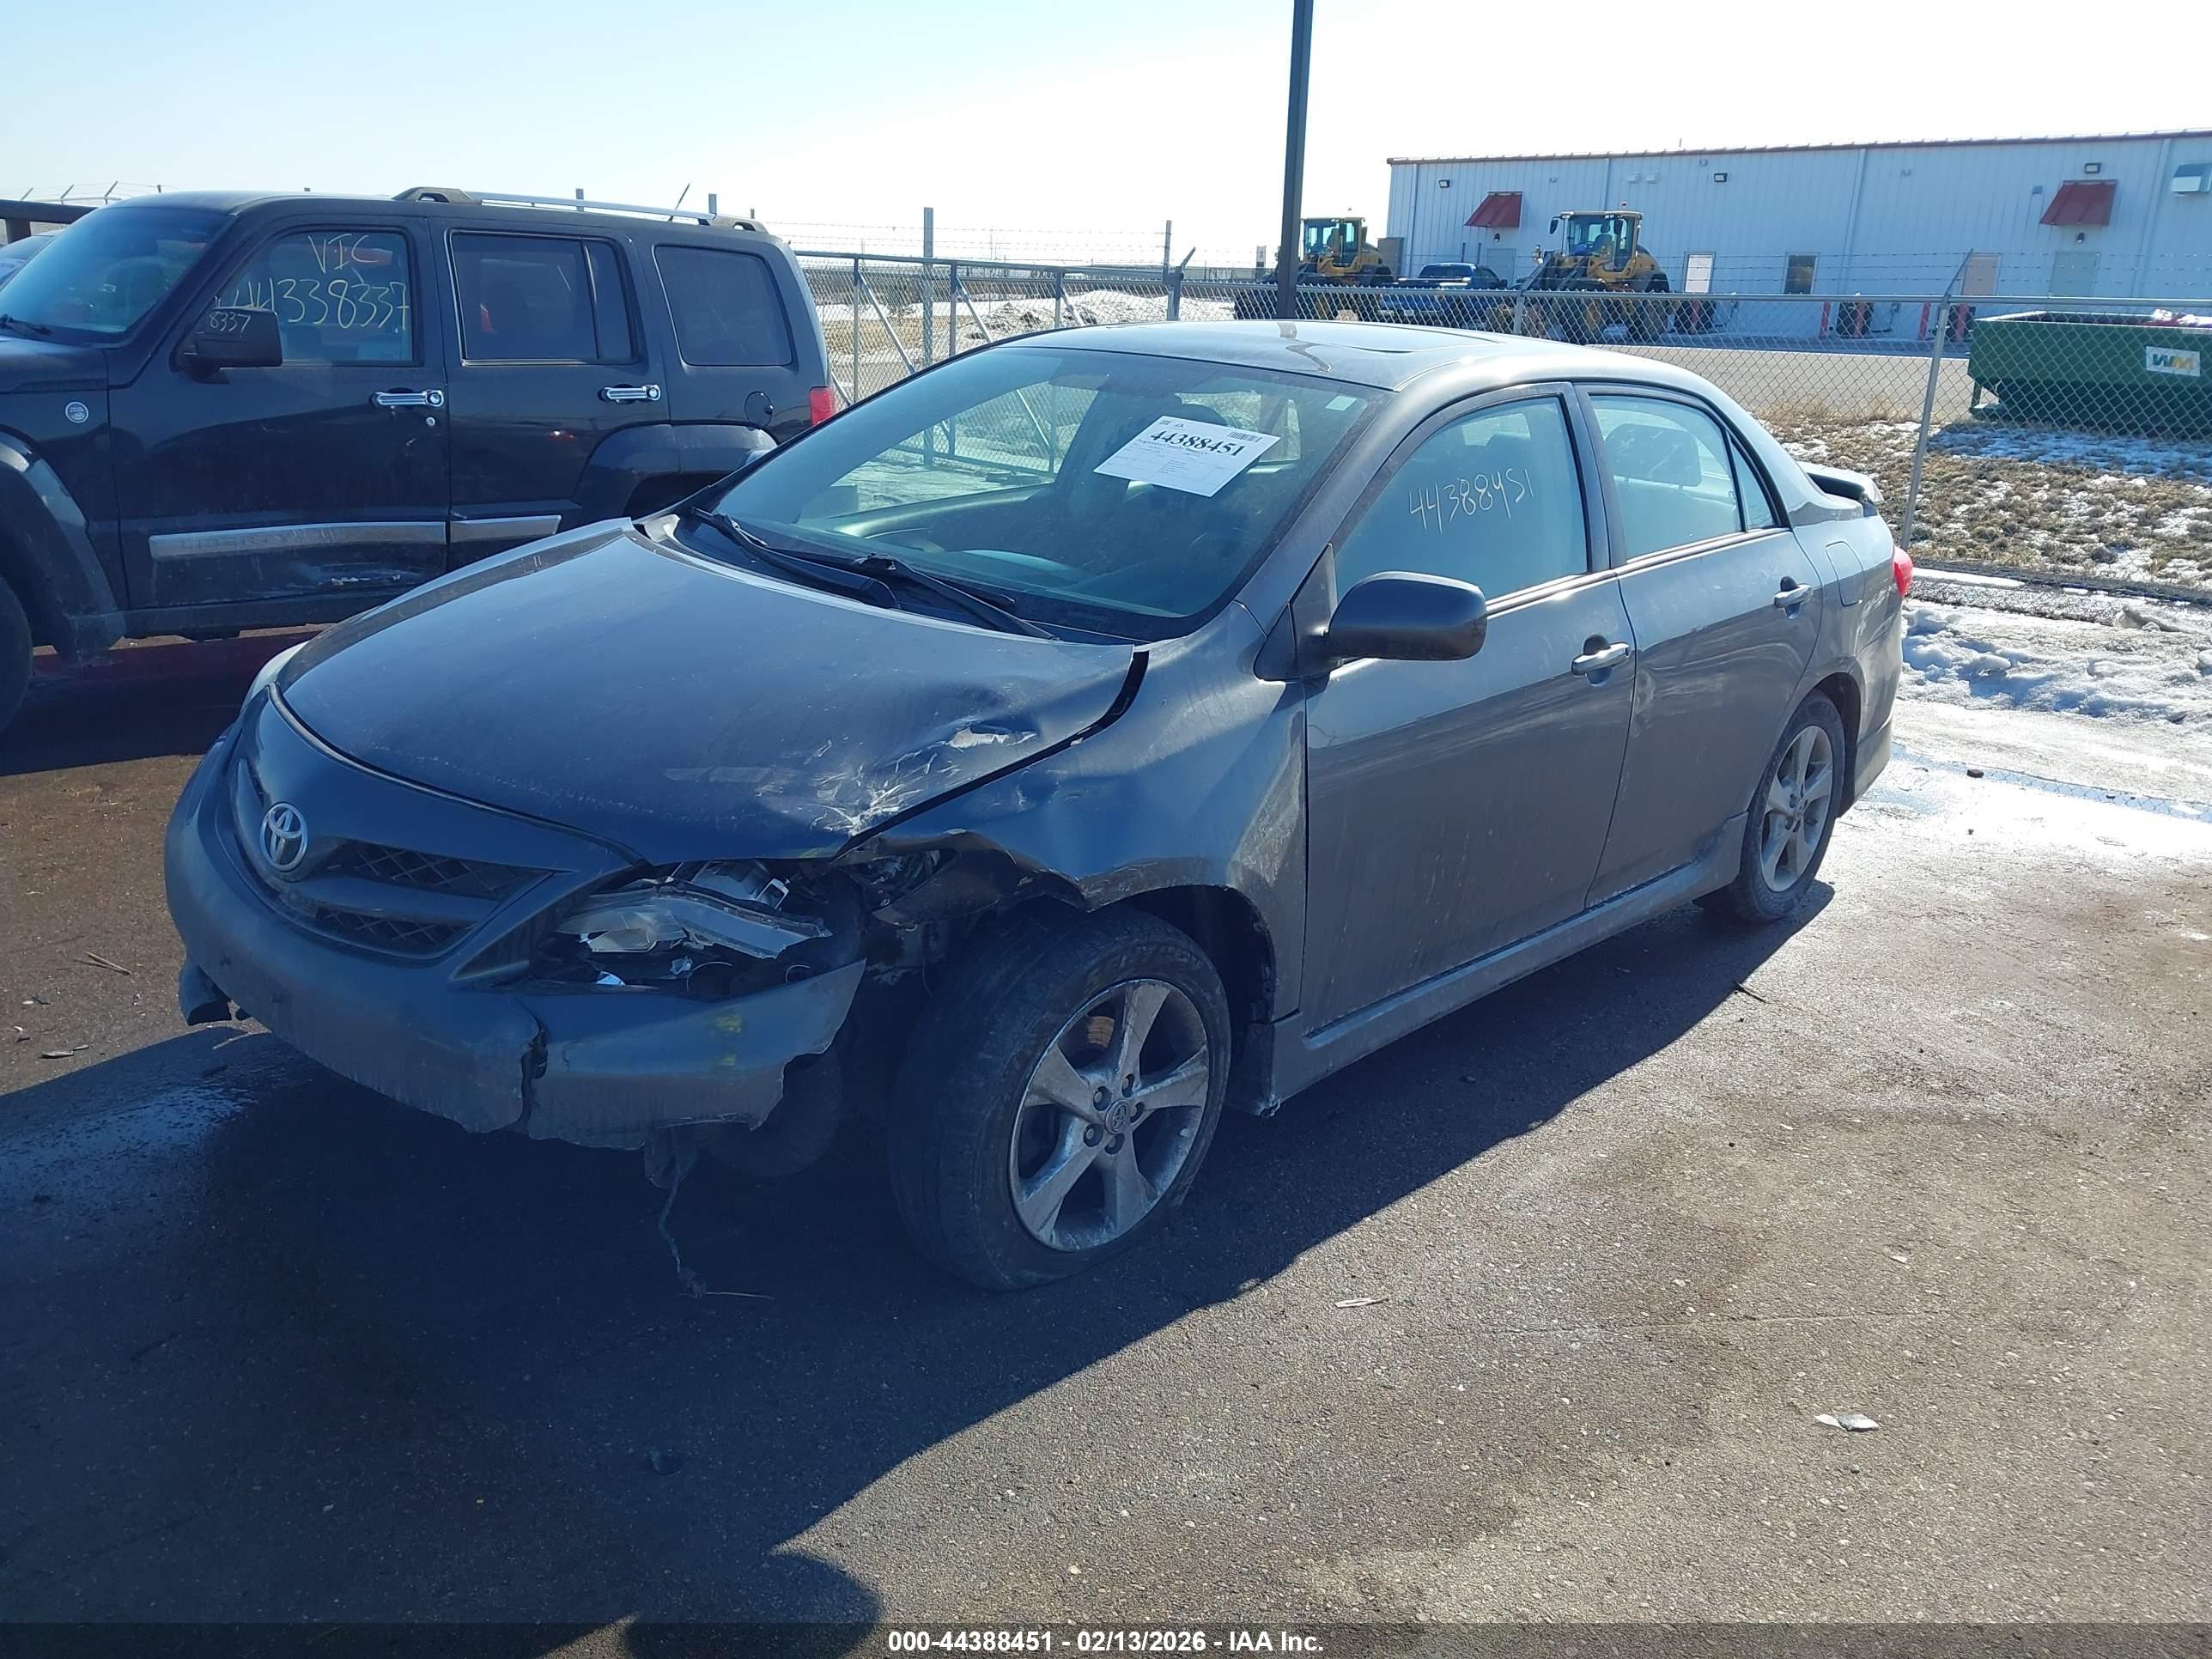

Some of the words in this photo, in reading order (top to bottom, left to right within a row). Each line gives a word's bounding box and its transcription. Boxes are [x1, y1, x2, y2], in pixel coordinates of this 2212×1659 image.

[307, 234, 379, 274] VIC
[209, 311, 251, 337] 8337
[2152, 353, 2197, 371] WM
[1151, 430, 1247, 457] 44388451
[1408, 468, 1534, 534] 44388451
